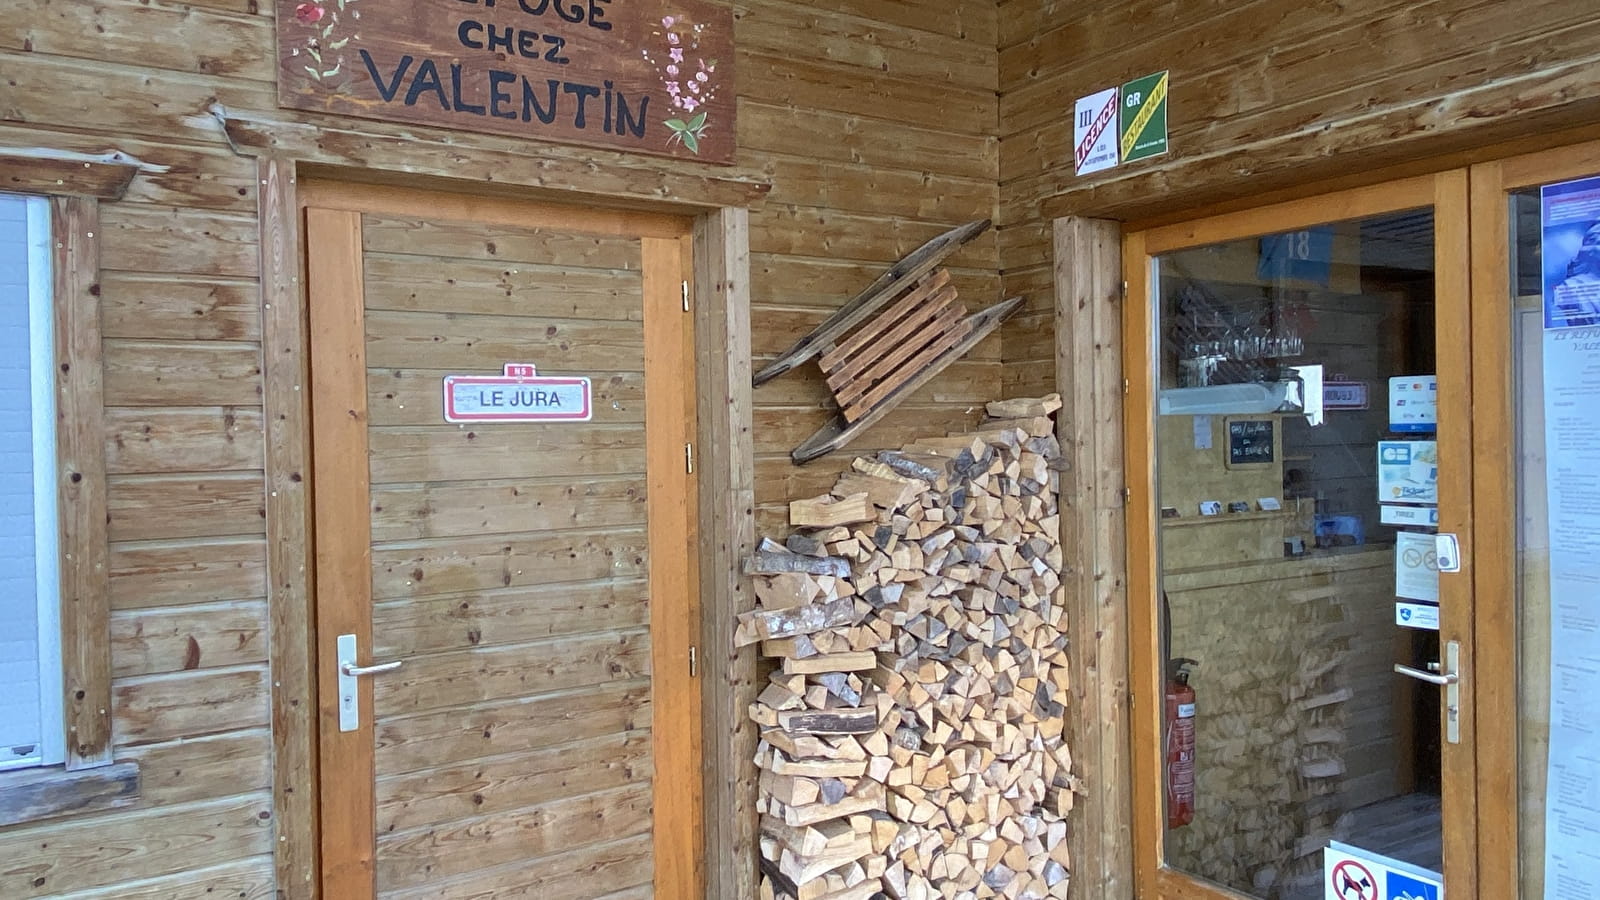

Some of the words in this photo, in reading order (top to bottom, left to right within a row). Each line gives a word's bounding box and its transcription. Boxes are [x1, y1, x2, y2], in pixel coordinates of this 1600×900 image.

[458, 20, 570, 64] CHEZ
[1122, 78, 1166, 157] RESTAURANT
[1126, 92, 1141, 108] GR
[1076, 98, 1116, 168] LICENCE
[480, 391, 504, 407] LE
[510, 391, 561, 407] JURA
